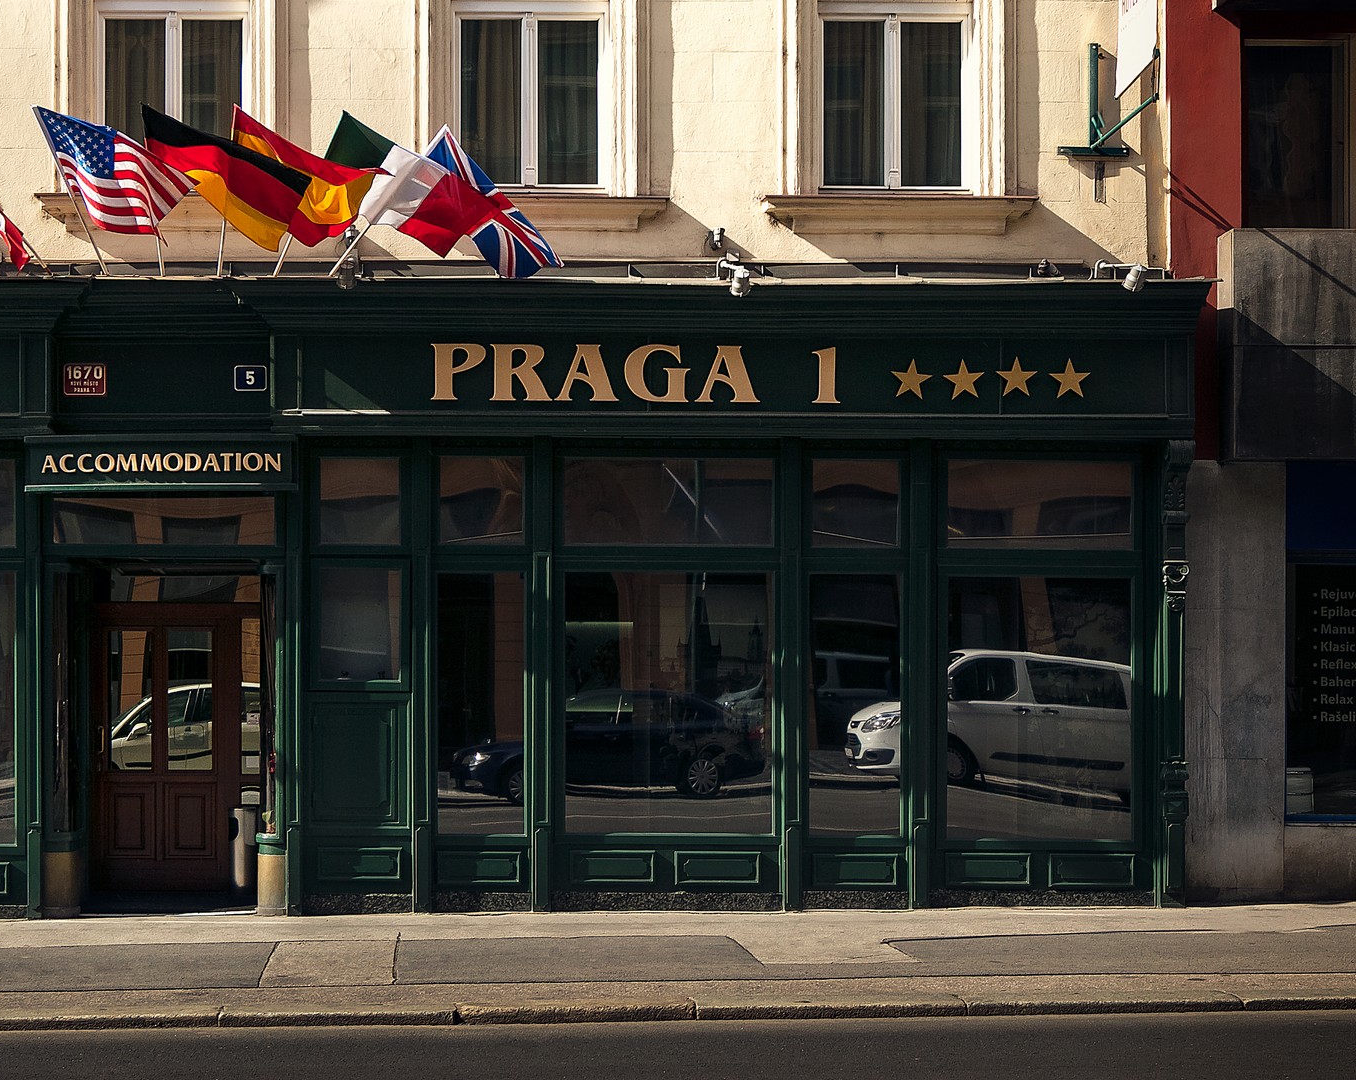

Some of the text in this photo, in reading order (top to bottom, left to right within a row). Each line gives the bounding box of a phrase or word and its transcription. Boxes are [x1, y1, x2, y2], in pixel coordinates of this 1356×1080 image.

[66, 365, 103, 380] 1670
[245, 370, 255, 385] 5
[430, 343, 841, 404] PRAGA 1
[41, 452, 282, 474] ACCOMMODATION
[1320, 693, 1354, 705] Relax
